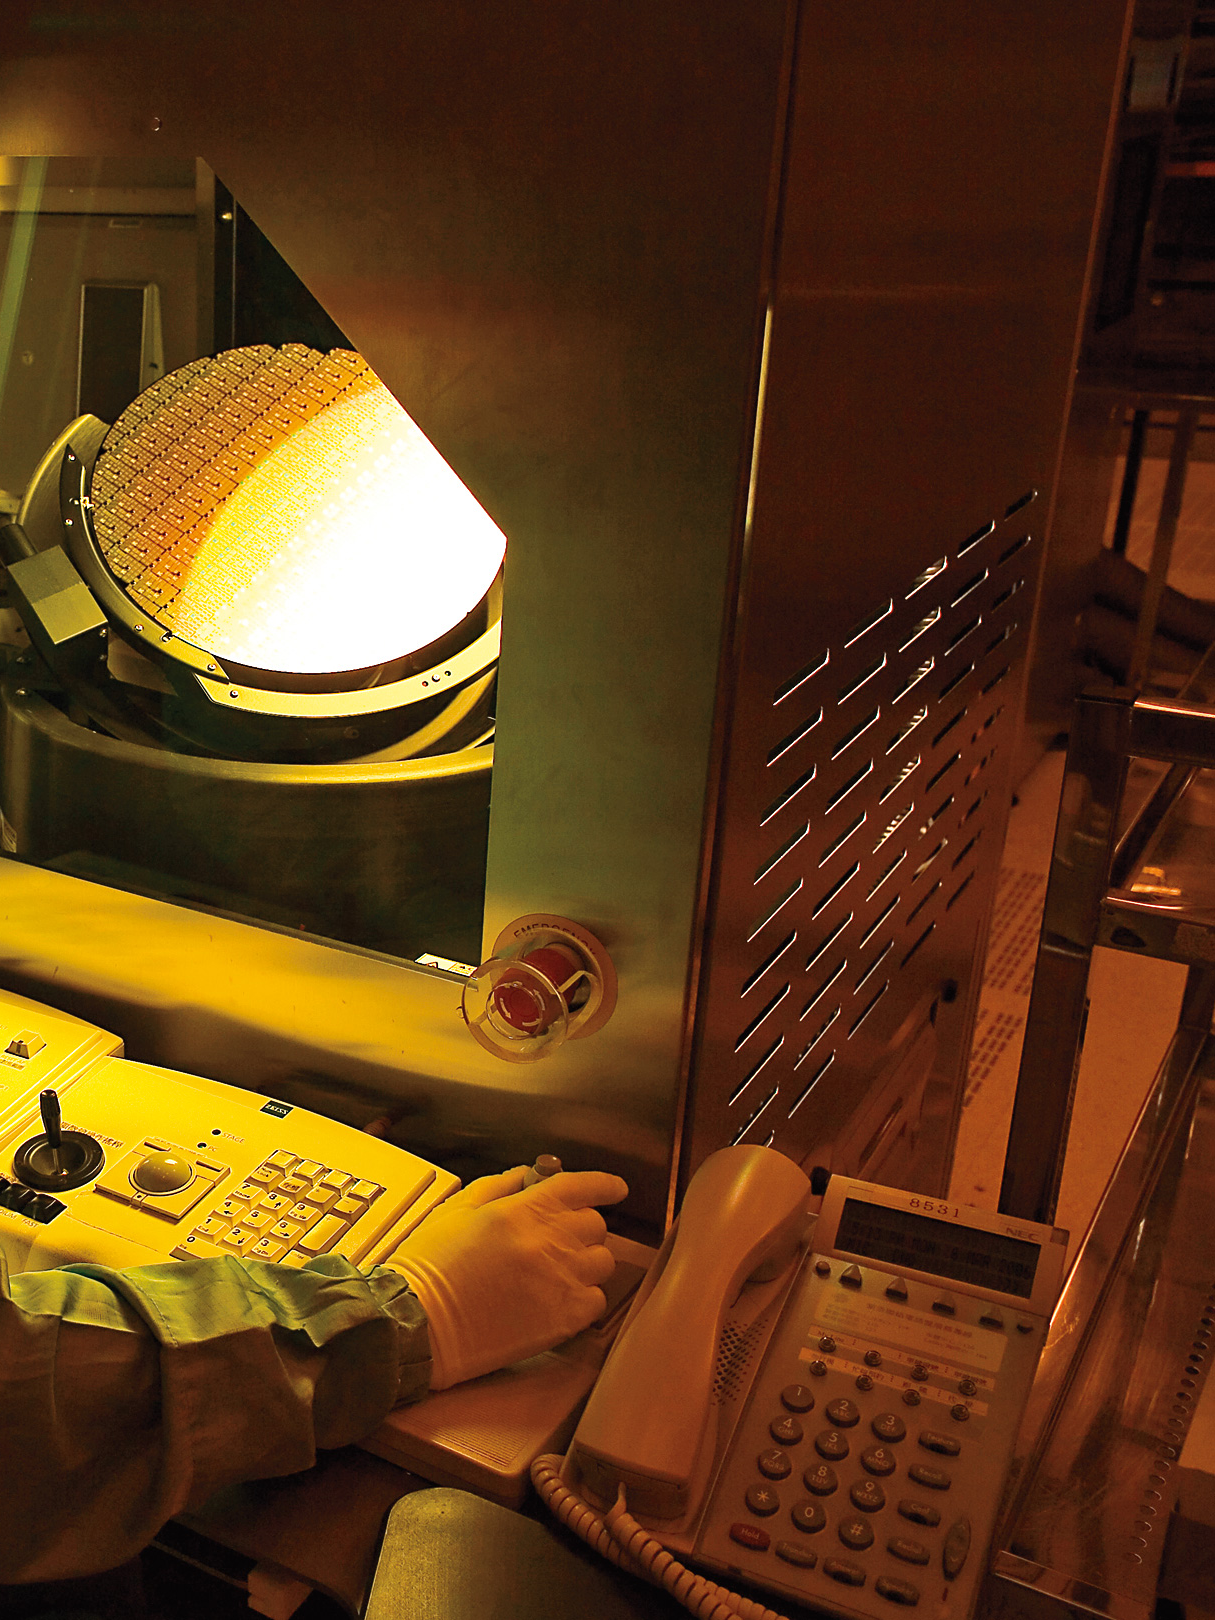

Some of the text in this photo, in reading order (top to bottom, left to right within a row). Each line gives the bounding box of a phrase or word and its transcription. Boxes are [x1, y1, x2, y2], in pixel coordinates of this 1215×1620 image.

[222, 1132, 246, 1144] STAGE
[909, 1198, 961, 1219] 8531
[22, 1219, 38, 1228] FAST
[1005, 1227, 1042, 1241] NEC
[797, 1386, 802, 1396] 1
[840, 1401, 848, 1410] 2
[834, 1409, 850, 1418] ABC
[783, 1418, 793, 1428] 4
[886, 1416, 895, 1425] 3
[778, 1427, 794, 1435] GHI
[880, 1423, 896, 1432] DEF
[829, 1433, 838, 1442] 5
[825, 1442, 838, 1450] JKL
[772, 1450, 782, 1460] 7
[875, 1449, 884, 1458] 6
[763, 1458, 785, 1470] PQRS
[867, 1456, 889, 1467] MNO
[818, 1466, 827, 1476] 8
[812, 1475, 829, 1484] TUV
[866, 1482, 874, 1492] 9
[856, 1490, 878, 1502] WXYZ
[805, 1507, 813, 1517] 0
[741, 1528, 760, 1540] Hold
